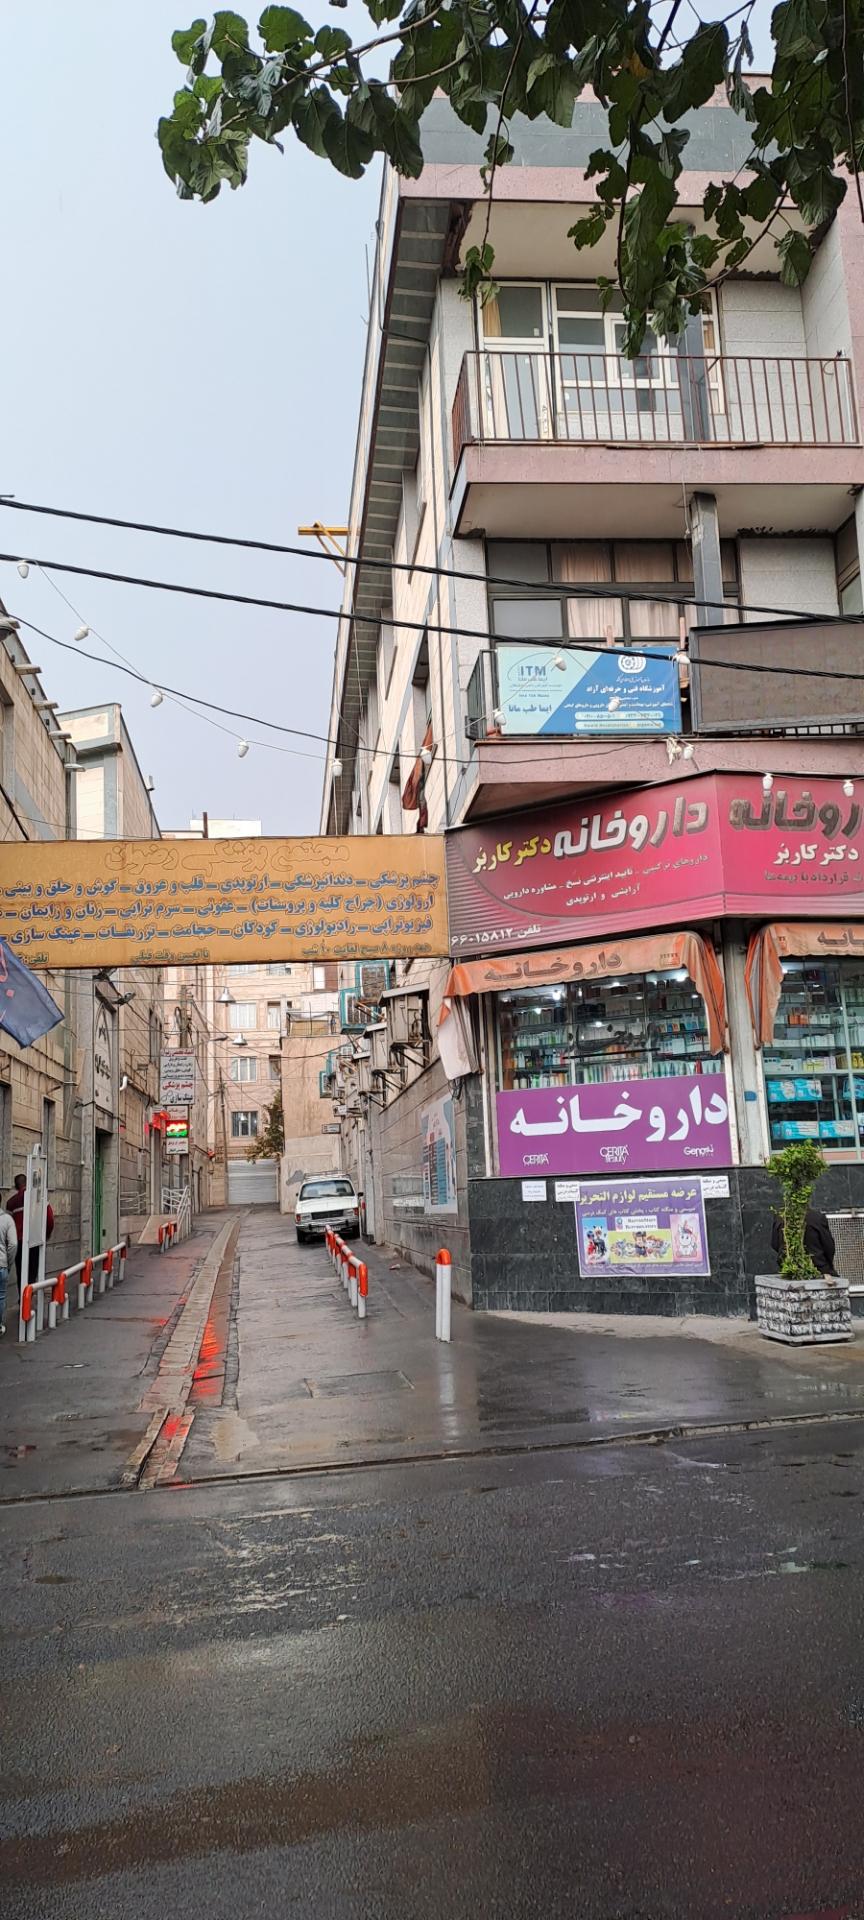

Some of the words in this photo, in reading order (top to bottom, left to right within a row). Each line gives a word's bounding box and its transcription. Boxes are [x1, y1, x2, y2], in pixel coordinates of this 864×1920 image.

[520, 665, 546, 676] ITM
[729, 790, 864, 840] روخانه
[553, 795, 709, 858] داروخانه
[513, 836, 552, 866] دکتر
[820, 844, 860, 866] دکتر
[4, 881, 33, 898] بینی
[45, 879, 72, 898] حلق
[86, 878, 118, 897] گوش
[134, 878, 168, 896] عروق
[169, 880, 178, 896] و
[180, 873, 204, 894] قلب
[220, 873, 270, 894] ارتوپدی
[369, 870, 409, 890] پزشکی
[412, 872, 439, 889] چشم
[35, 884, 44, 899] و
[76, 882, 84, 898] و
[566, 891, 597, 906] ارتوپدی
[611, 882, 640, 898] آرایشی
[20, 900, 62, 922] زایمان
[75, 900, 104, 919] زنان
[119, 899, 154, 919] تراپی
[155, 903, 181, 920] سرم
[197, 897, 234, 918] عفونی
[309, 901, 317, 915] و
[319, 894, 343, 913] کلیه
[386, 891, 435, 913] ارولوژی
[64, 906, 73, 920] و
[10, 926, 46, 945] سازی
[47, 925, 82, 945] عینک
[172, 921, 217, 940] حجامت
[232, 919, 279, 939] کودکان
[294, 917, 356, 938] رادیولوژی
[517, 924, 541, 939] تلفن
[483, 951, 623, 982] داروخانه
[510, 1085, 729, 1143] داروخانه
[612, 1188, 637, 1204] لوازم
[638, 1187, 669, 1202] مستقیم
[671, 1186, 697, 1201] عرضه
